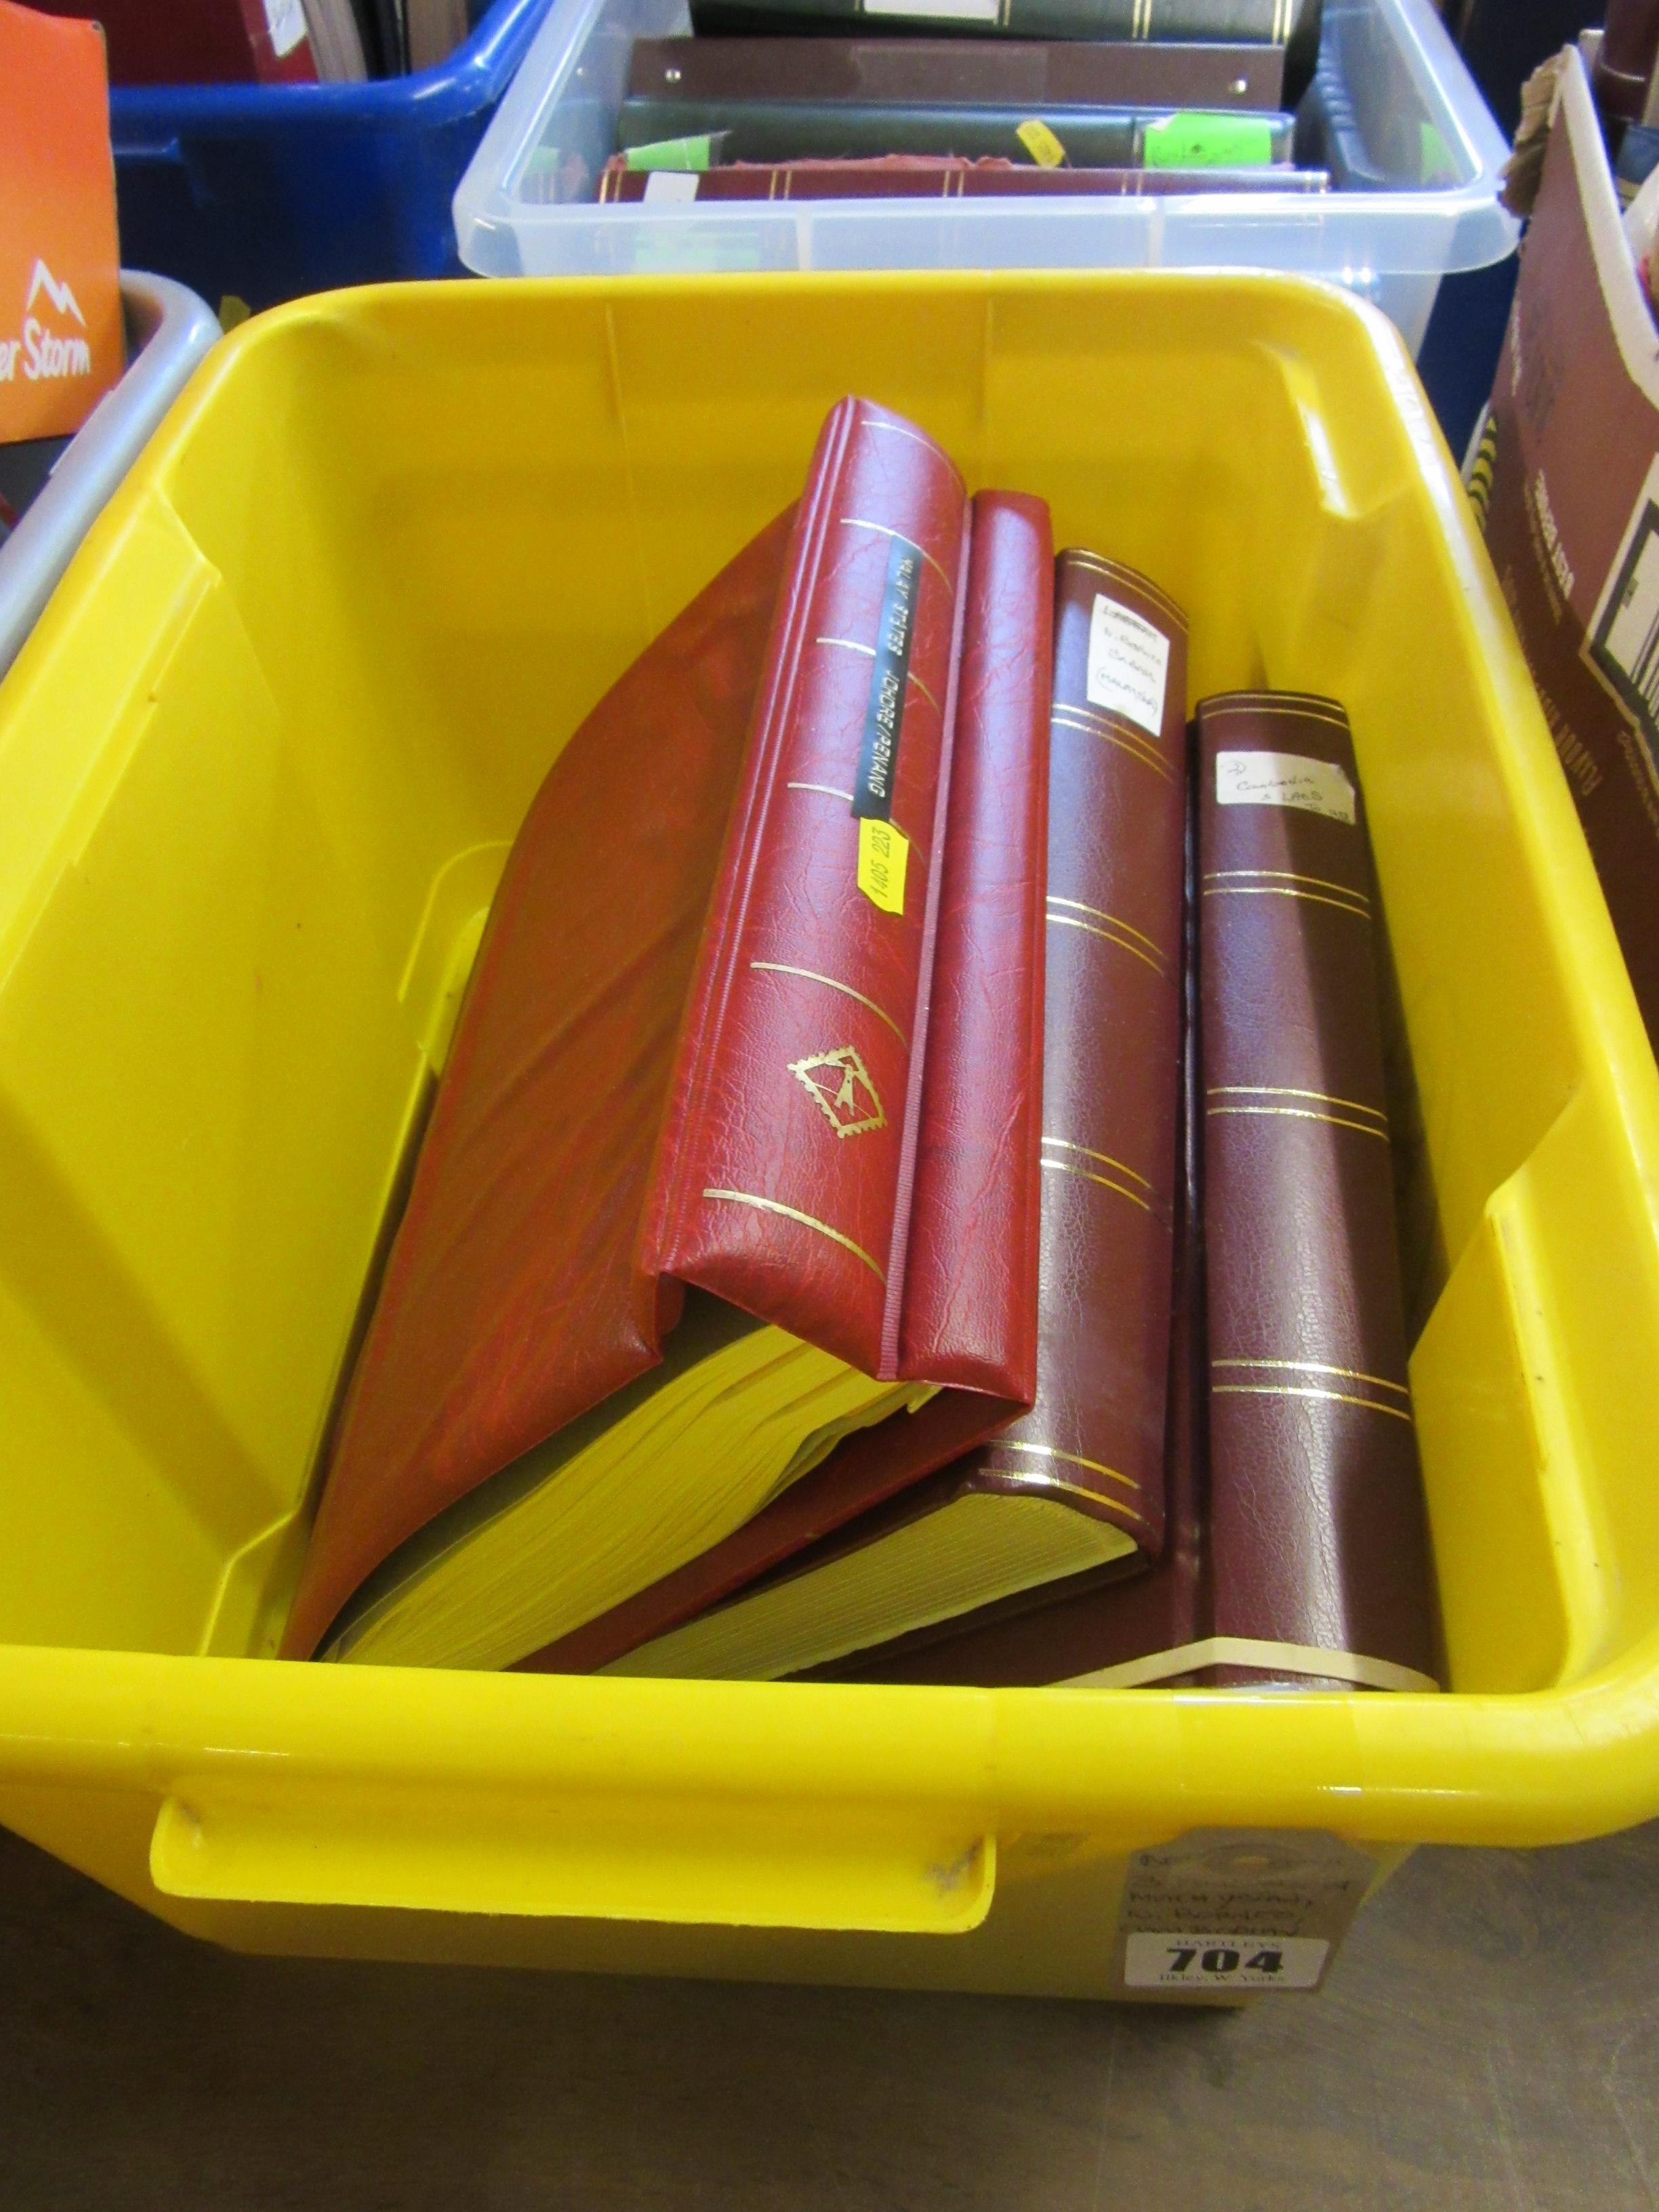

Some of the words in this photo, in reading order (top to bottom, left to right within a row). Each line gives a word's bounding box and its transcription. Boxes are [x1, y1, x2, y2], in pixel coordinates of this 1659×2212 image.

[22, 317, 91, 380] Storm
[888, 603, 909, 656] STATES
[867, 670, 899, 798] JOHORE/PENANG
[872, 827, 891, 859] 223
[870, 859, 888, 897] 1405
[1166, 1948, 1284, 1973] 704
